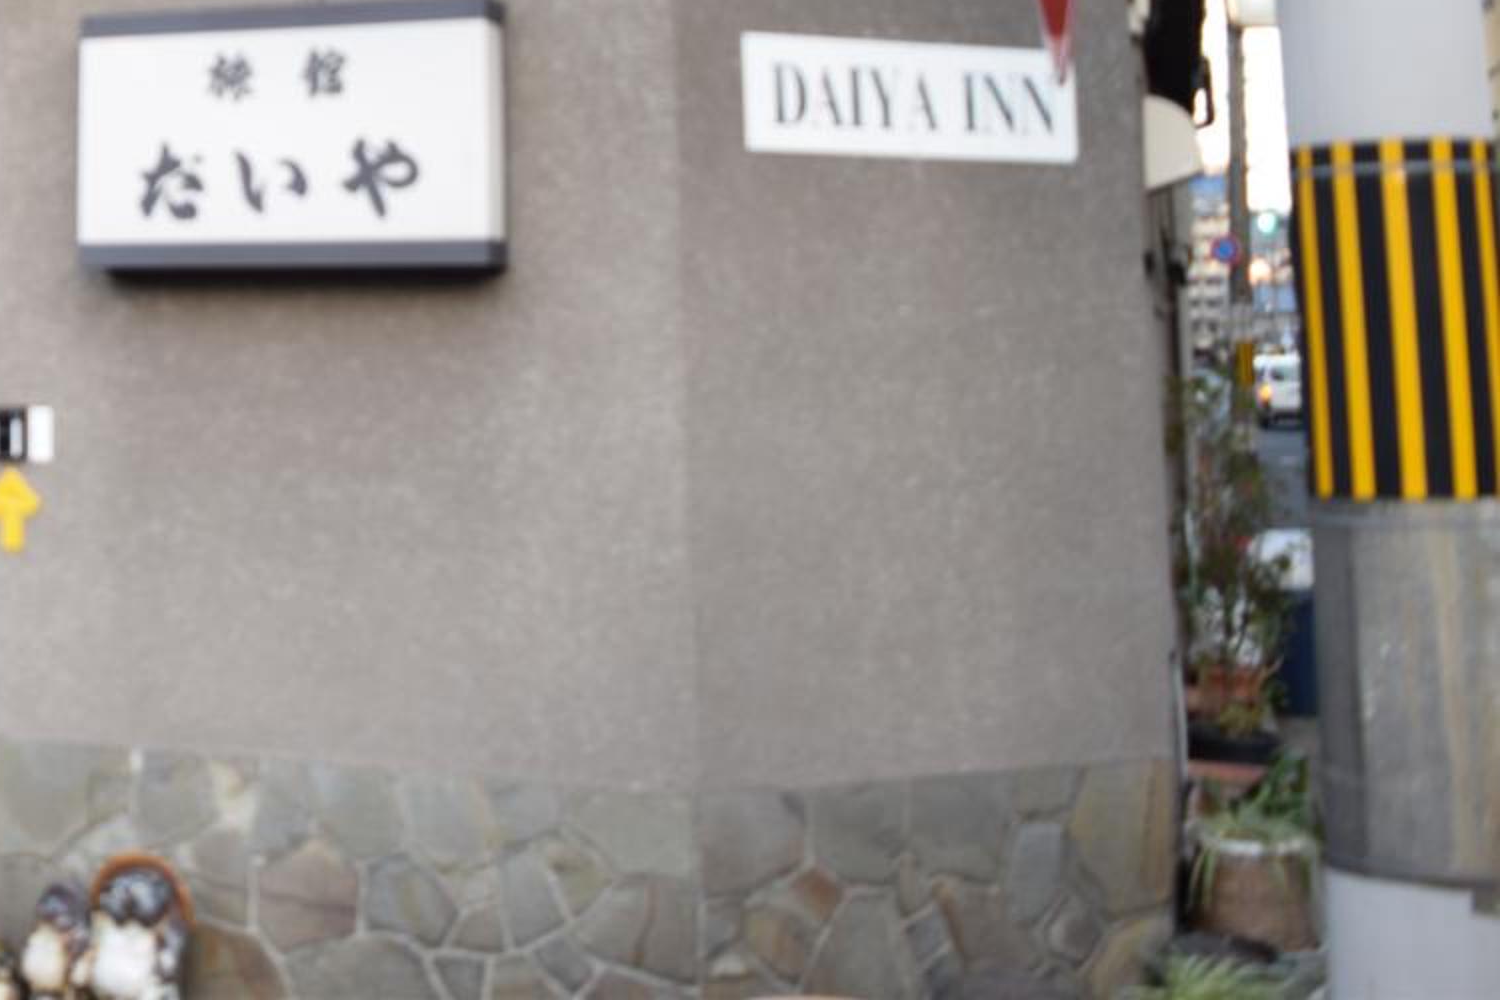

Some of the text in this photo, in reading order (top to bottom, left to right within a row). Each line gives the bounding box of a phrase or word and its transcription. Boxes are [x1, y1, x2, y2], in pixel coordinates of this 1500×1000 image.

[772, 62, 1059, 136] DAIYA INN
[139, 137, 419, 221] だいや
